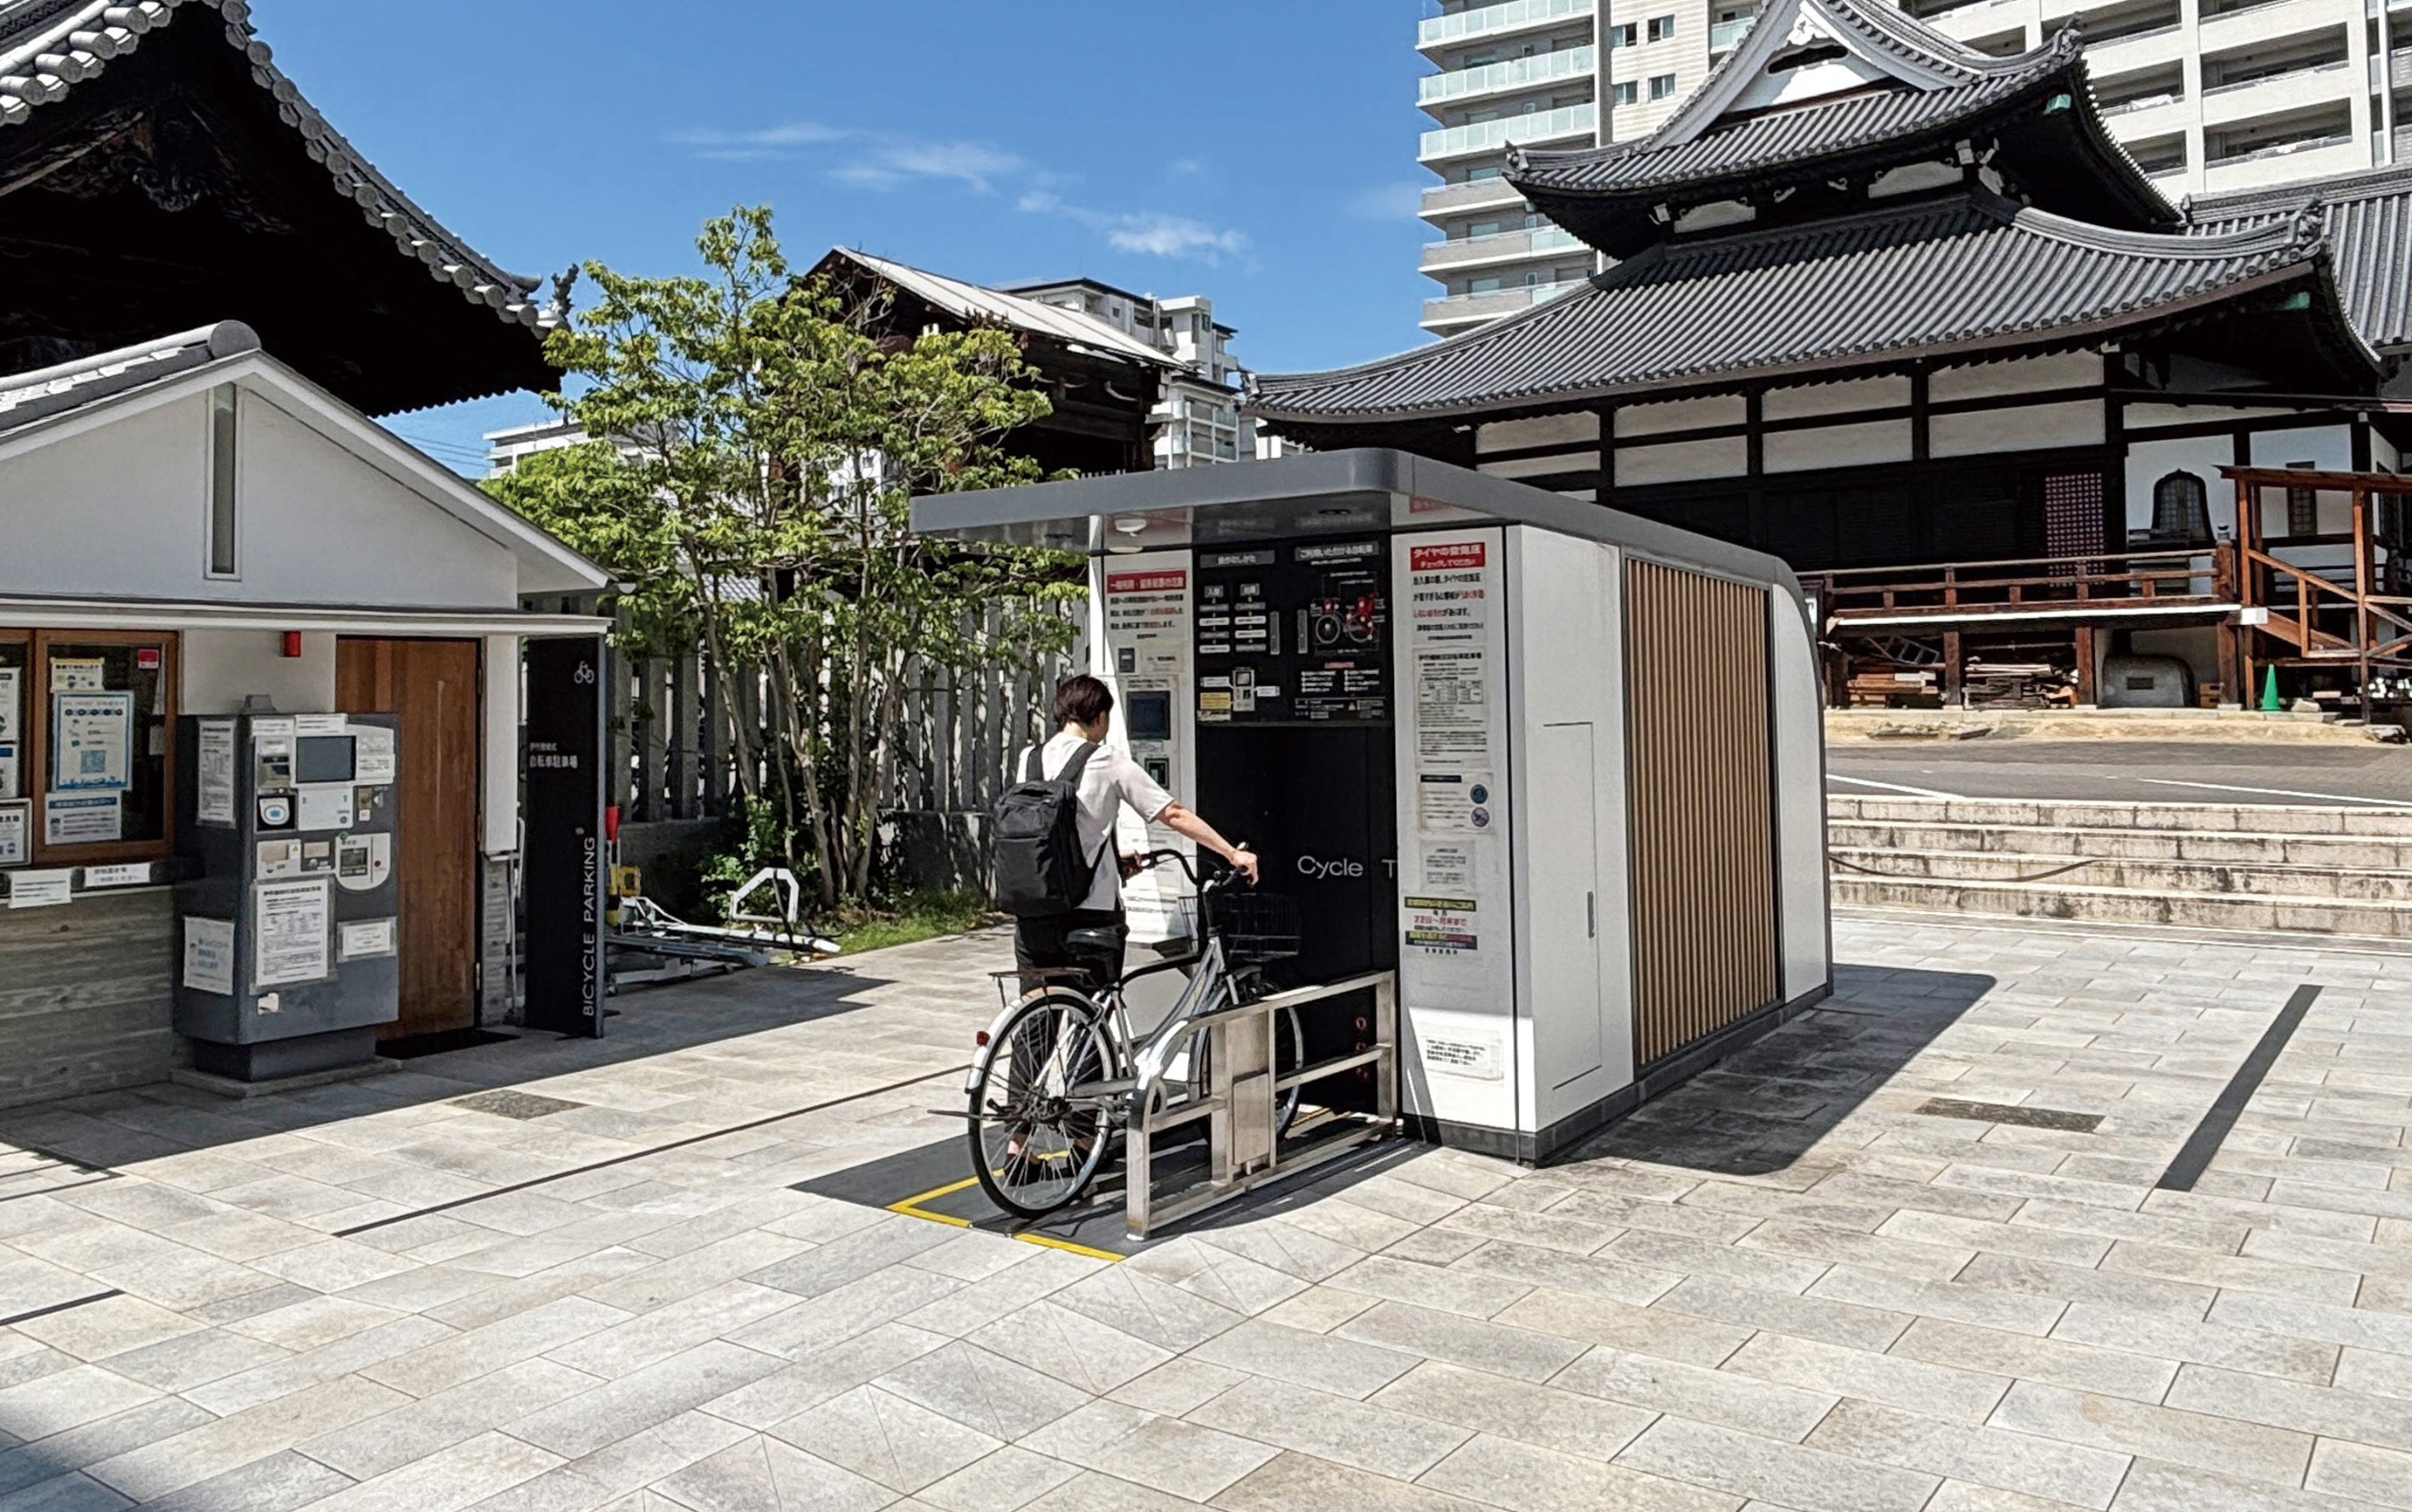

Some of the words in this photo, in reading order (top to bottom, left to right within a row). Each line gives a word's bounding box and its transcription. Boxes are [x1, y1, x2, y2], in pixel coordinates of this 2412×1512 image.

[583, 836, 596, 923] PARKING
[1297, 856, 1364, 879] Cycle
[582, 932, 595, 1016] BICYCLE
